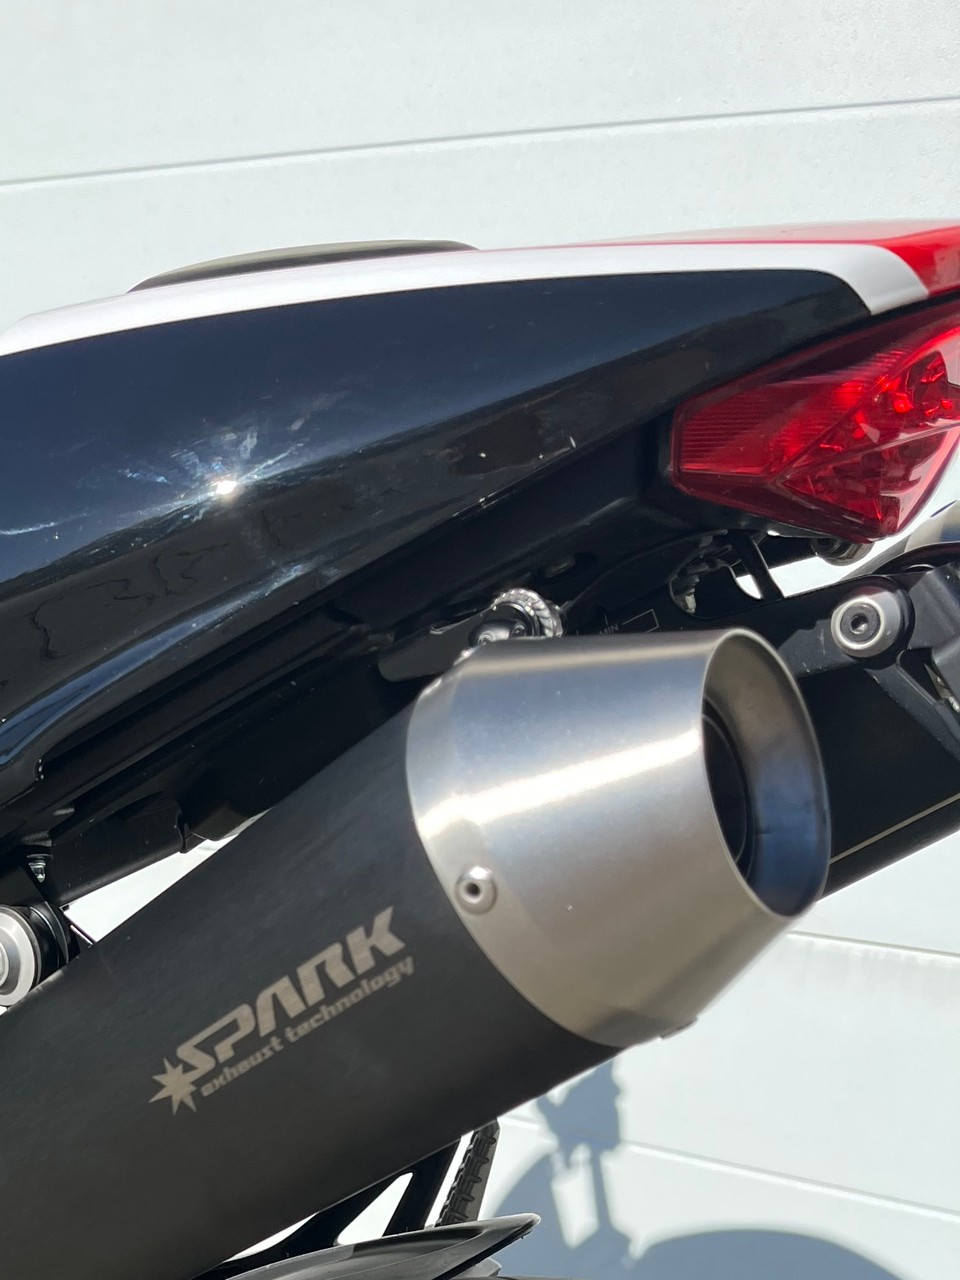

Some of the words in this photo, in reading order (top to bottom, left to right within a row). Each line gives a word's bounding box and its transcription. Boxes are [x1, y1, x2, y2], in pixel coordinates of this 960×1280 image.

[176, 906, 407, 1080] SPARK
[200, 1036, 285, 1097] exhaust
[284, 955, 415, 1043] technology
